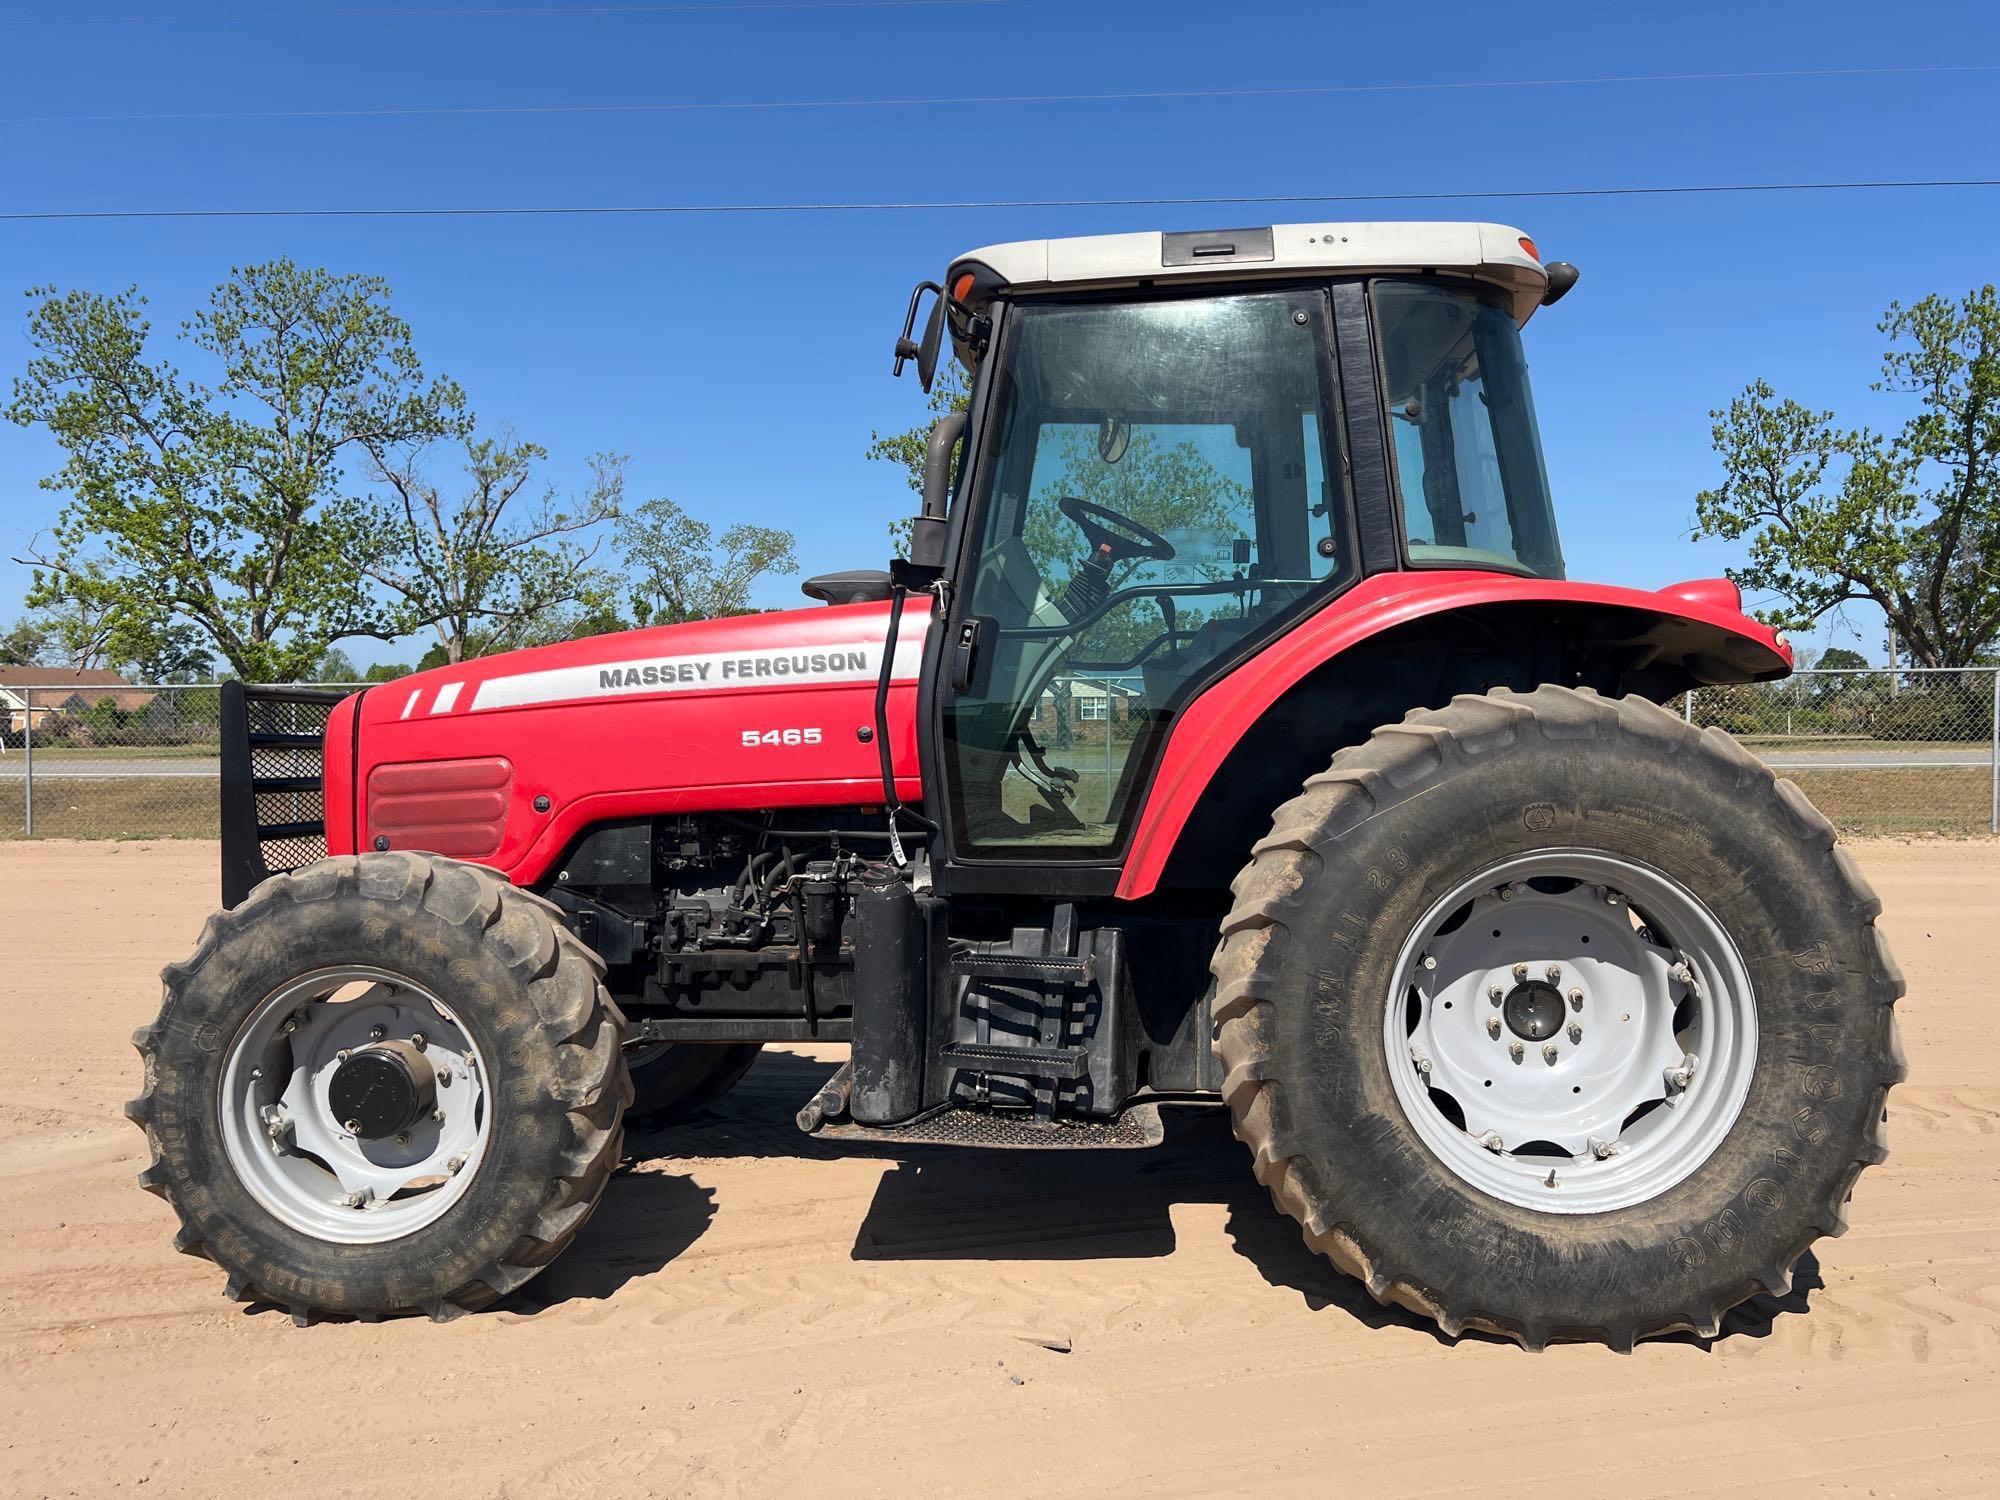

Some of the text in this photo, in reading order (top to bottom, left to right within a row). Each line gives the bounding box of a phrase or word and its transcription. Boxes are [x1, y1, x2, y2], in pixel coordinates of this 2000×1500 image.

[600, 651, 867, 689] MASSEY FERGUSON
[741, 727, 823, 748] 5465
[361, 916, 541, 1138] Firestone
[1668, 940, 1844, 1275] Firestone
